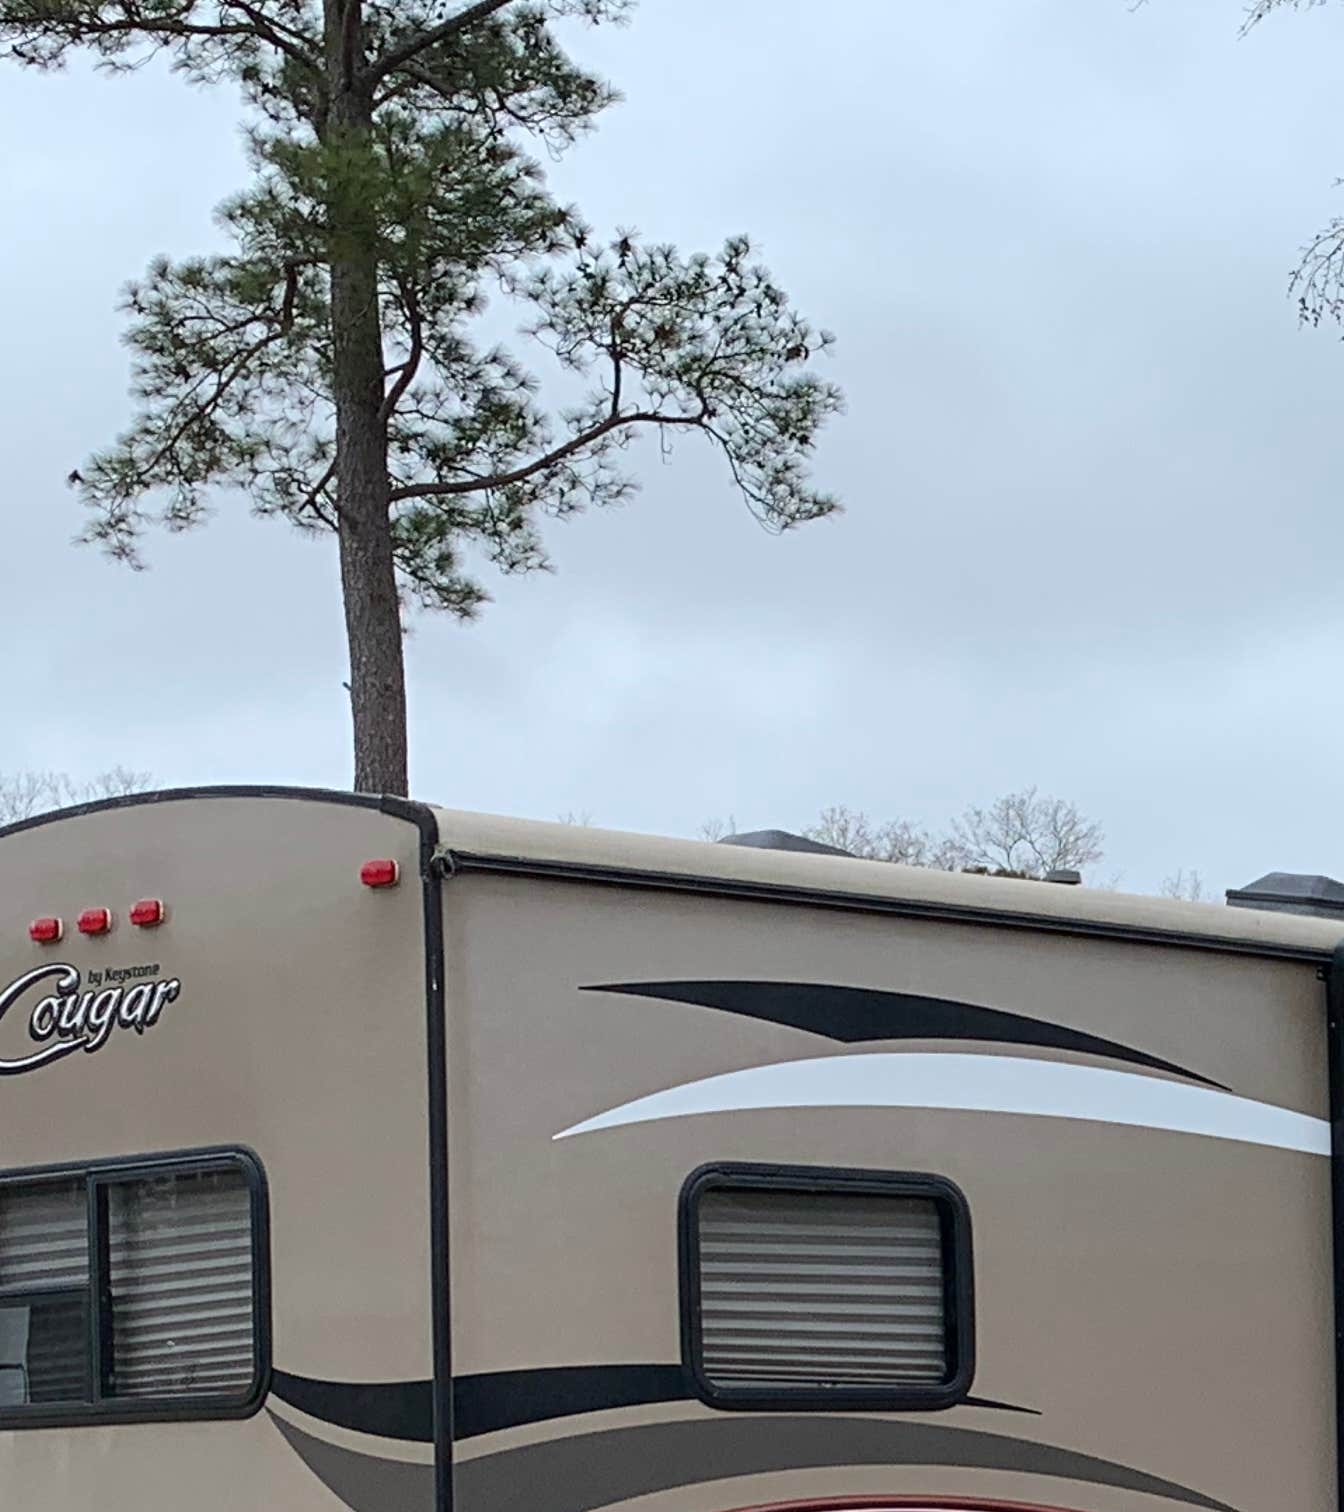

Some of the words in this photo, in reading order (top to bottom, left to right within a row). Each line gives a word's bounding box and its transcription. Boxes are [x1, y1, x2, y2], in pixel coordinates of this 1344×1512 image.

[88, 969, 102, 986] by
[104, 964, 160, 983] Keystone
[0, 962, 181, 1076] Cougar
